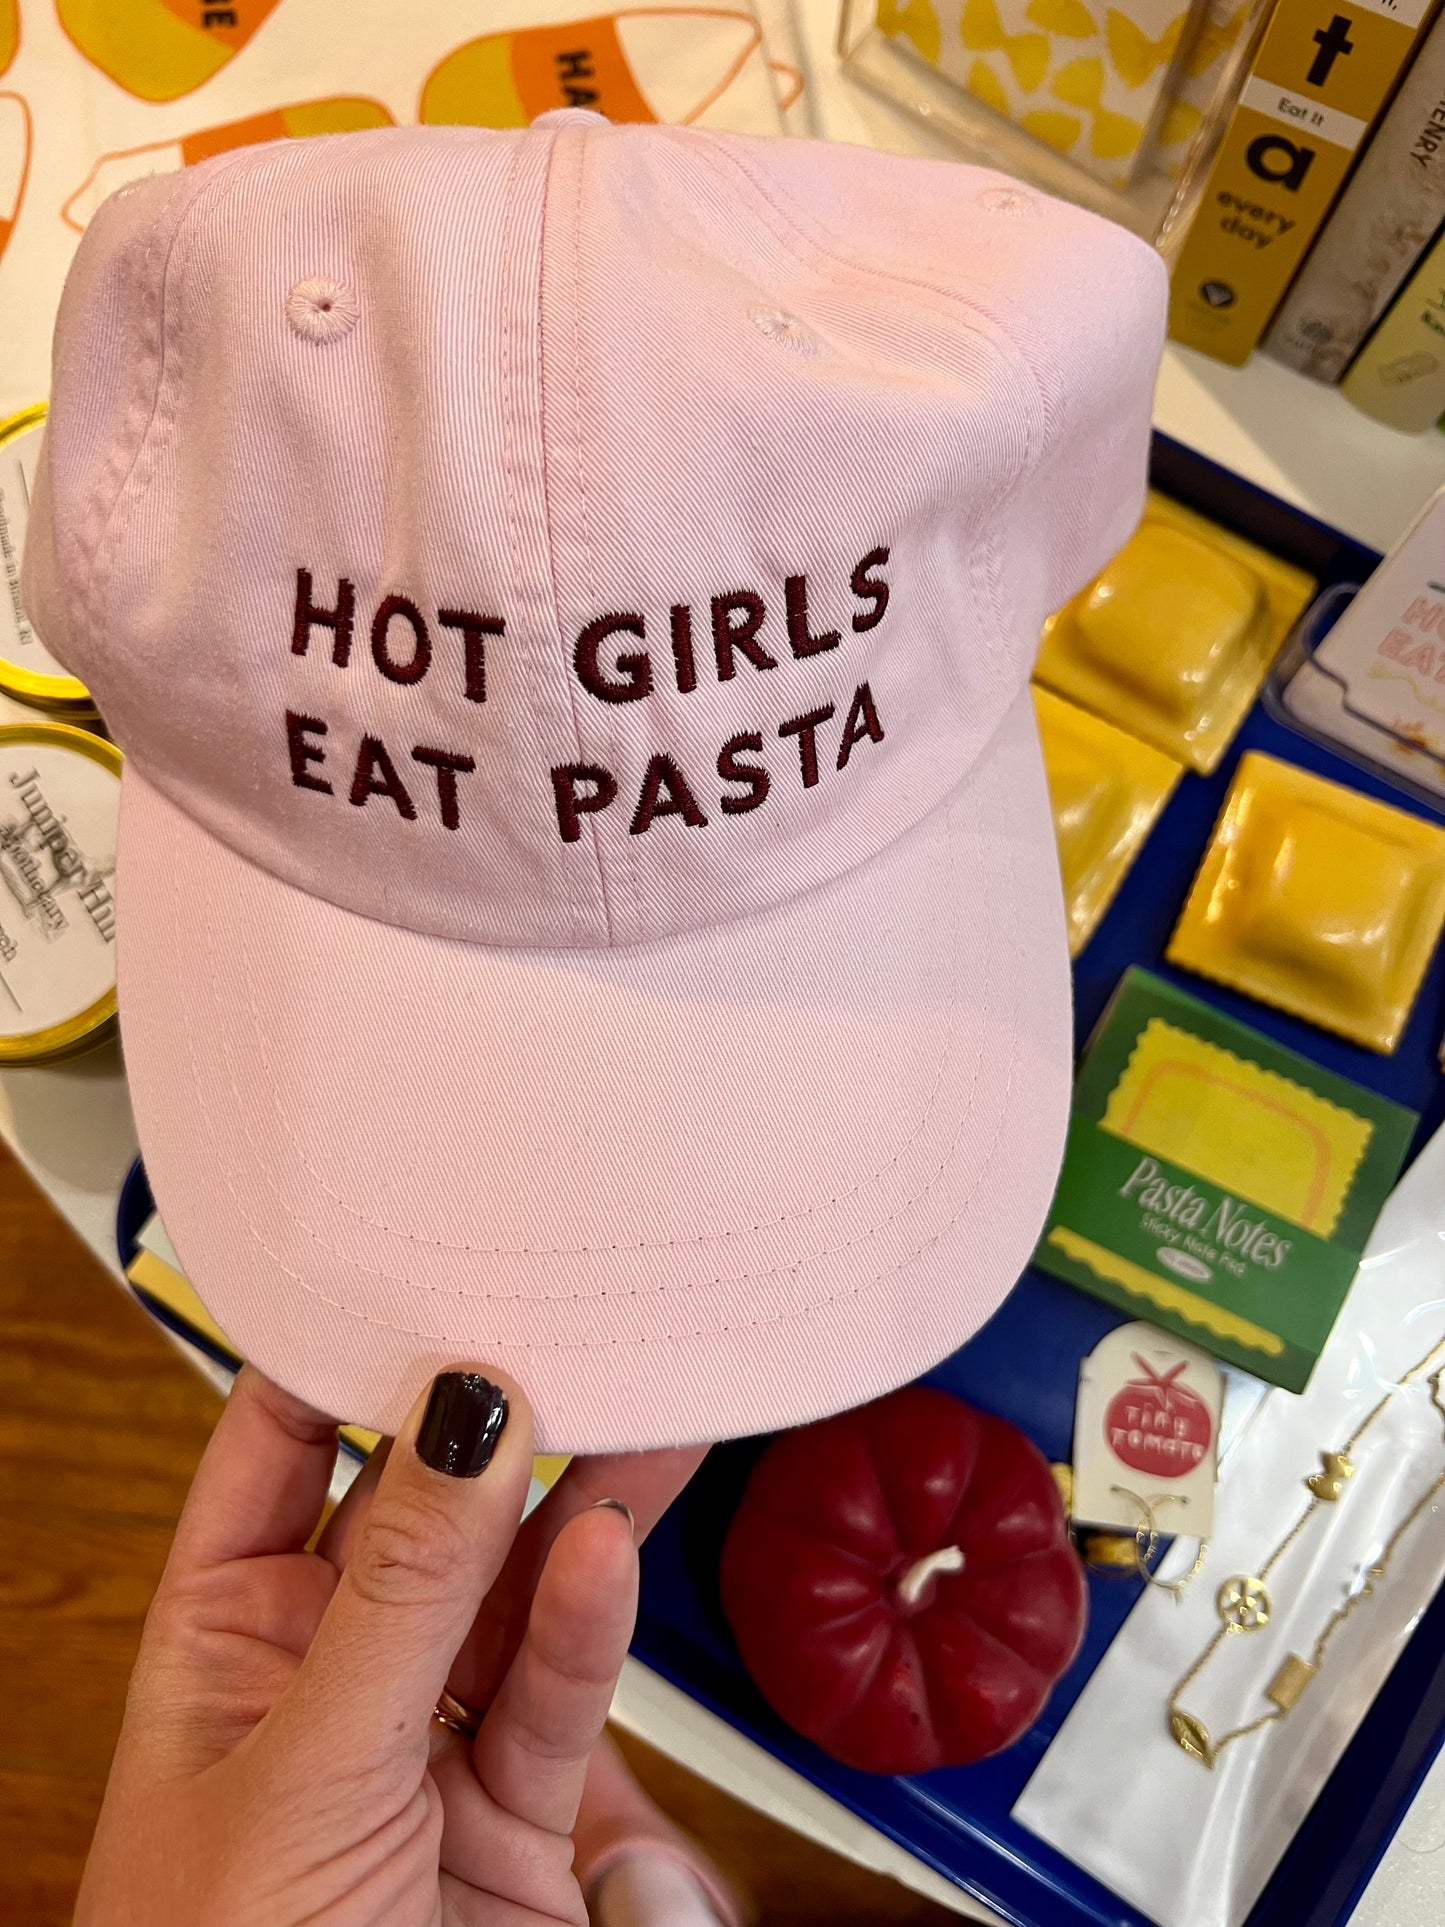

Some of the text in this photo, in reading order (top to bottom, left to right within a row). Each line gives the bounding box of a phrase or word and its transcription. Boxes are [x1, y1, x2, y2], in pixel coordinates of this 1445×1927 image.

[1278, 97, 1307, 119] Eat
[1410, 93, 1445, 169] ENRY
[1245, 133, 1316, 194] a
[1217, 190, 1296, 236] every
[1219, 216, 1274, 250] day
[290, 545, 891, 705] HOT GIRLS
[284, 682, 886, 843] EAT PASTA
[1118, 1156, 1209, 1229] Pasta
[1200, 1195, 1293, 1271] Notes
